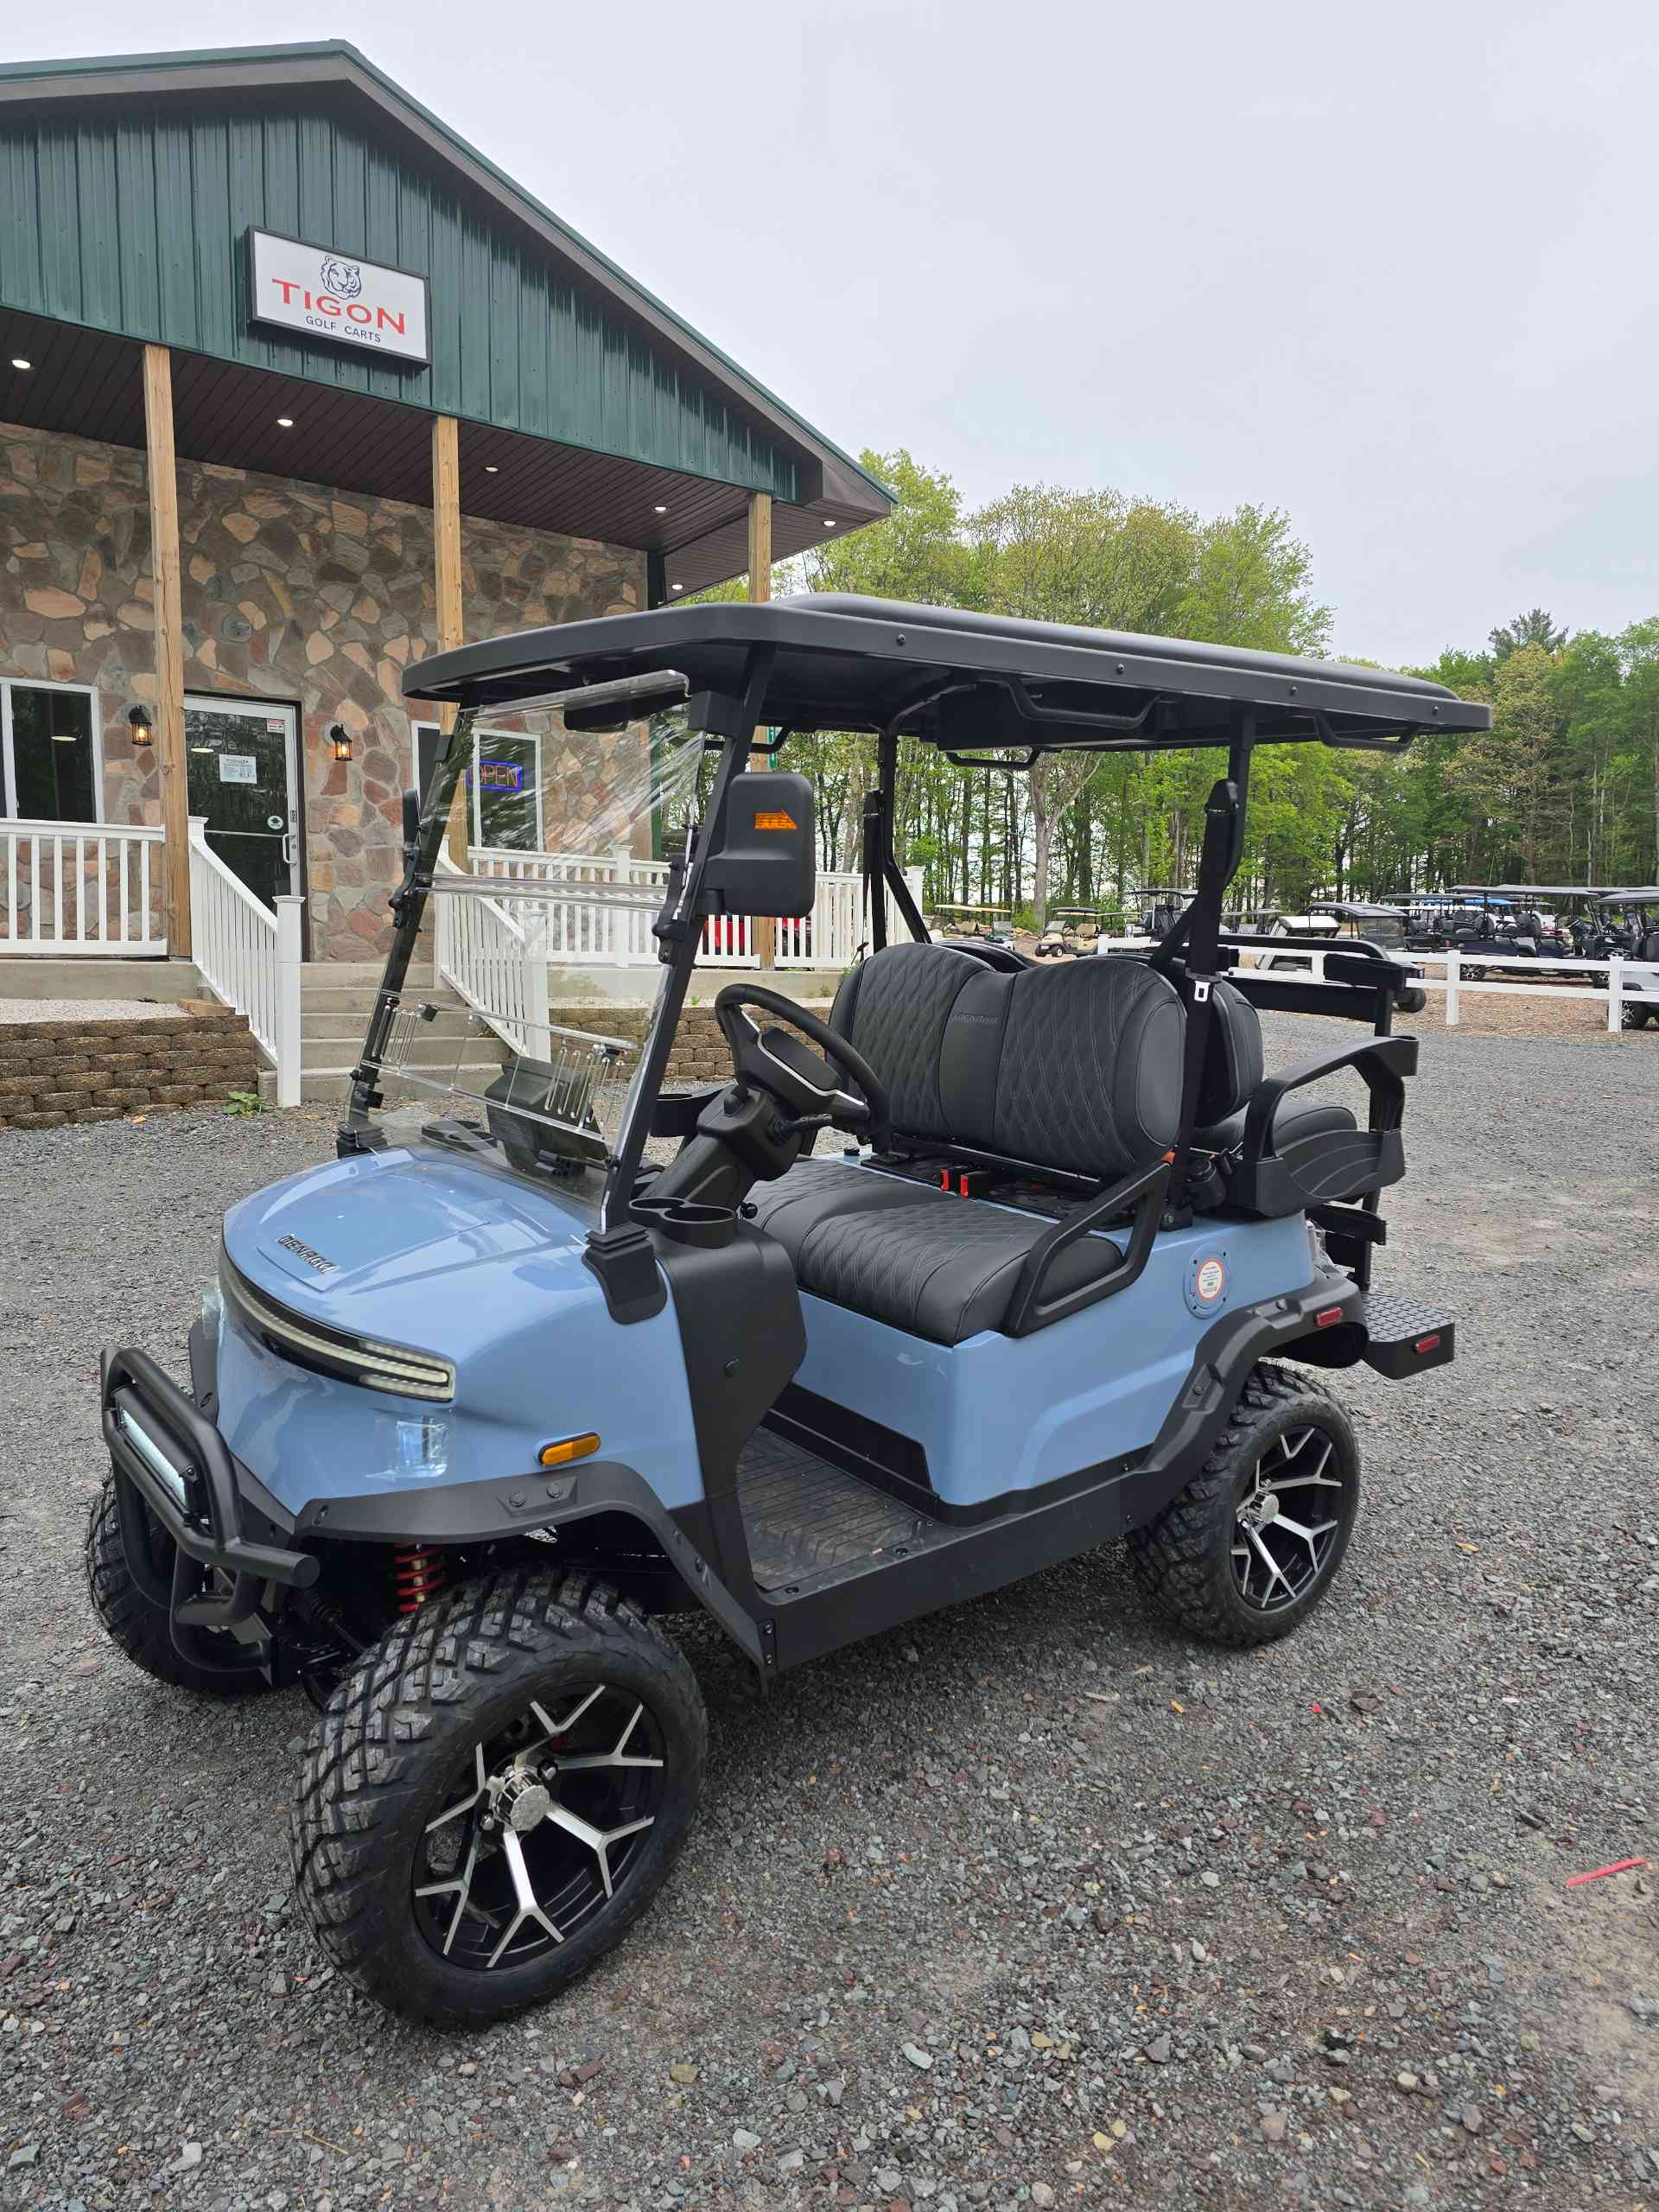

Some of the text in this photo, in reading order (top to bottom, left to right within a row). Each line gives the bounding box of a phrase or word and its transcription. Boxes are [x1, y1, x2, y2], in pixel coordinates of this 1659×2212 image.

[272, 278, 405, 334] TIGON
[306, 315, 381, 342] GOLF CARTS
